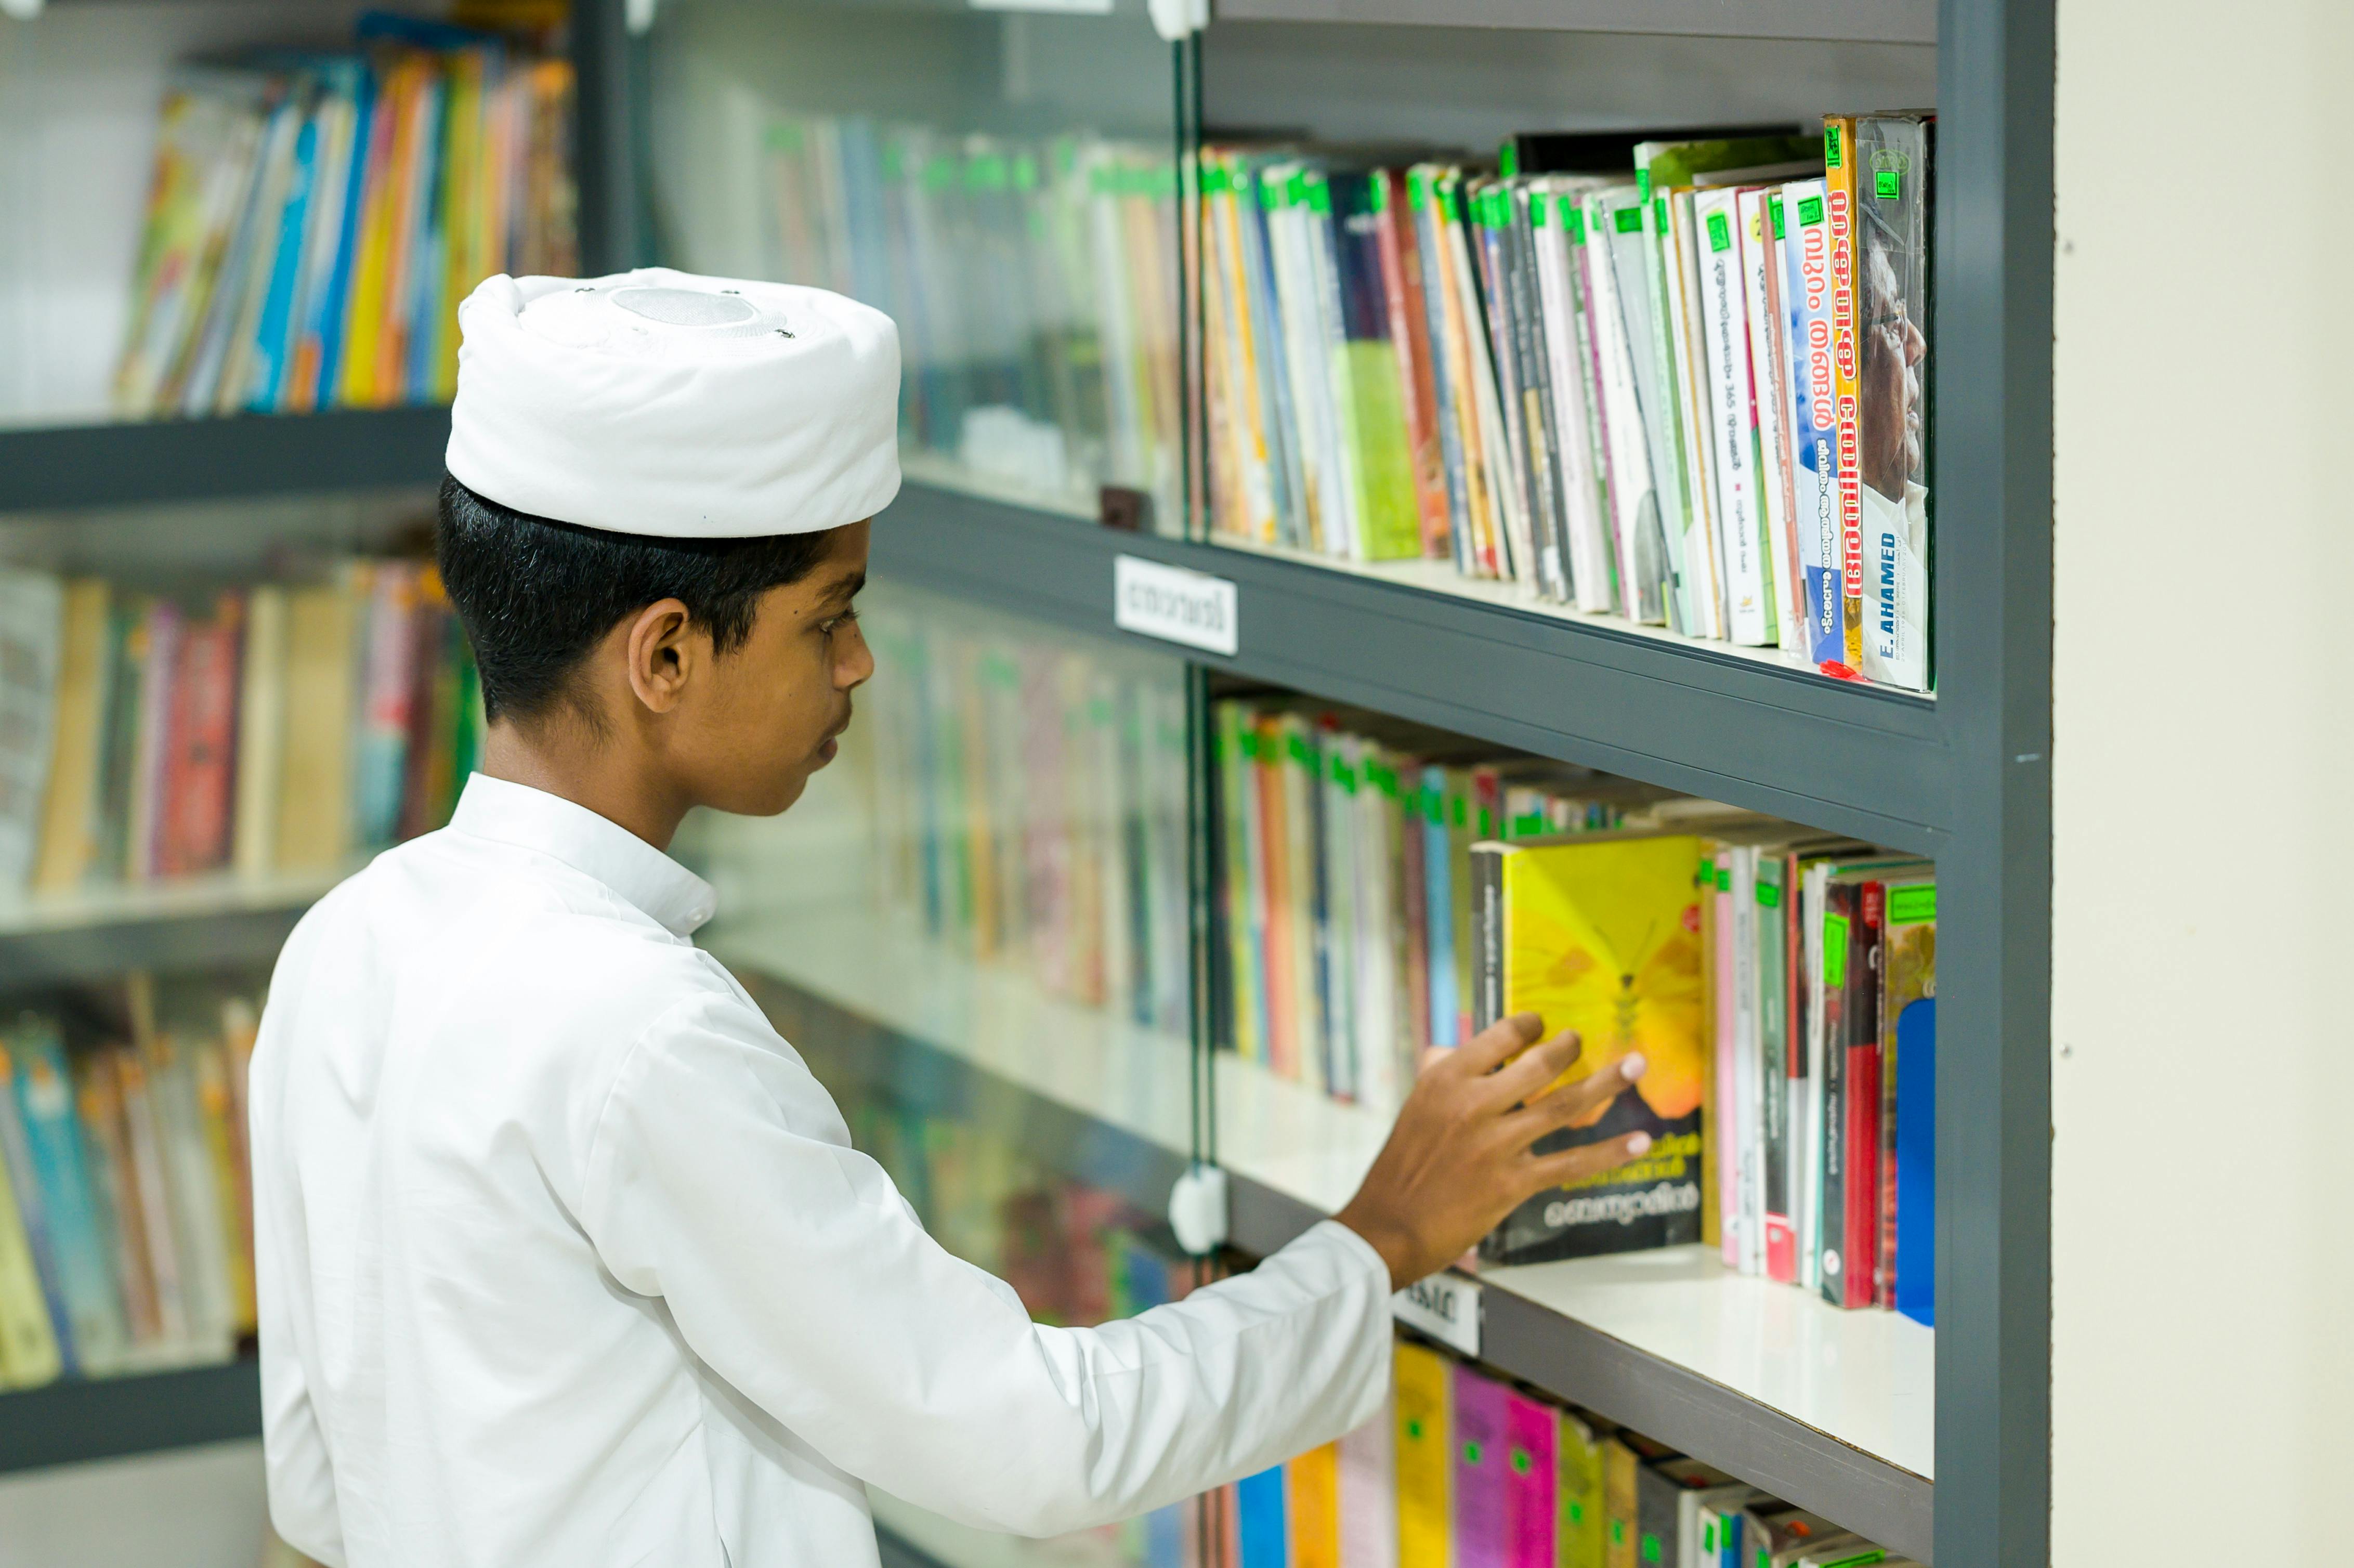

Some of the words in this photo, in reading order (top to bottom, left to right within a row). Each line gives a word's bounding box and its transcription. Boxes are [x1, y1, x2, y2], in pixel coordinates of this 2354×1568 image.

[1802, 224, 1825, 310] മ്പുറം
[1828, 190, 1855, 378] കഥകൾ
[1725, 384, 1735, 408] 365
[1809, 320, 1835, 428] തങ്ങൾ
[1817, 439, 1830, 493] ജീവിതം
[1819, 494, 1833, 569] ആത്മീയത
[1822, 571, 1833, 634] പോരാട്ടം
[1880, 533, 1895, 635] AHAMED
[1880, 639, 1893, 659] E.
